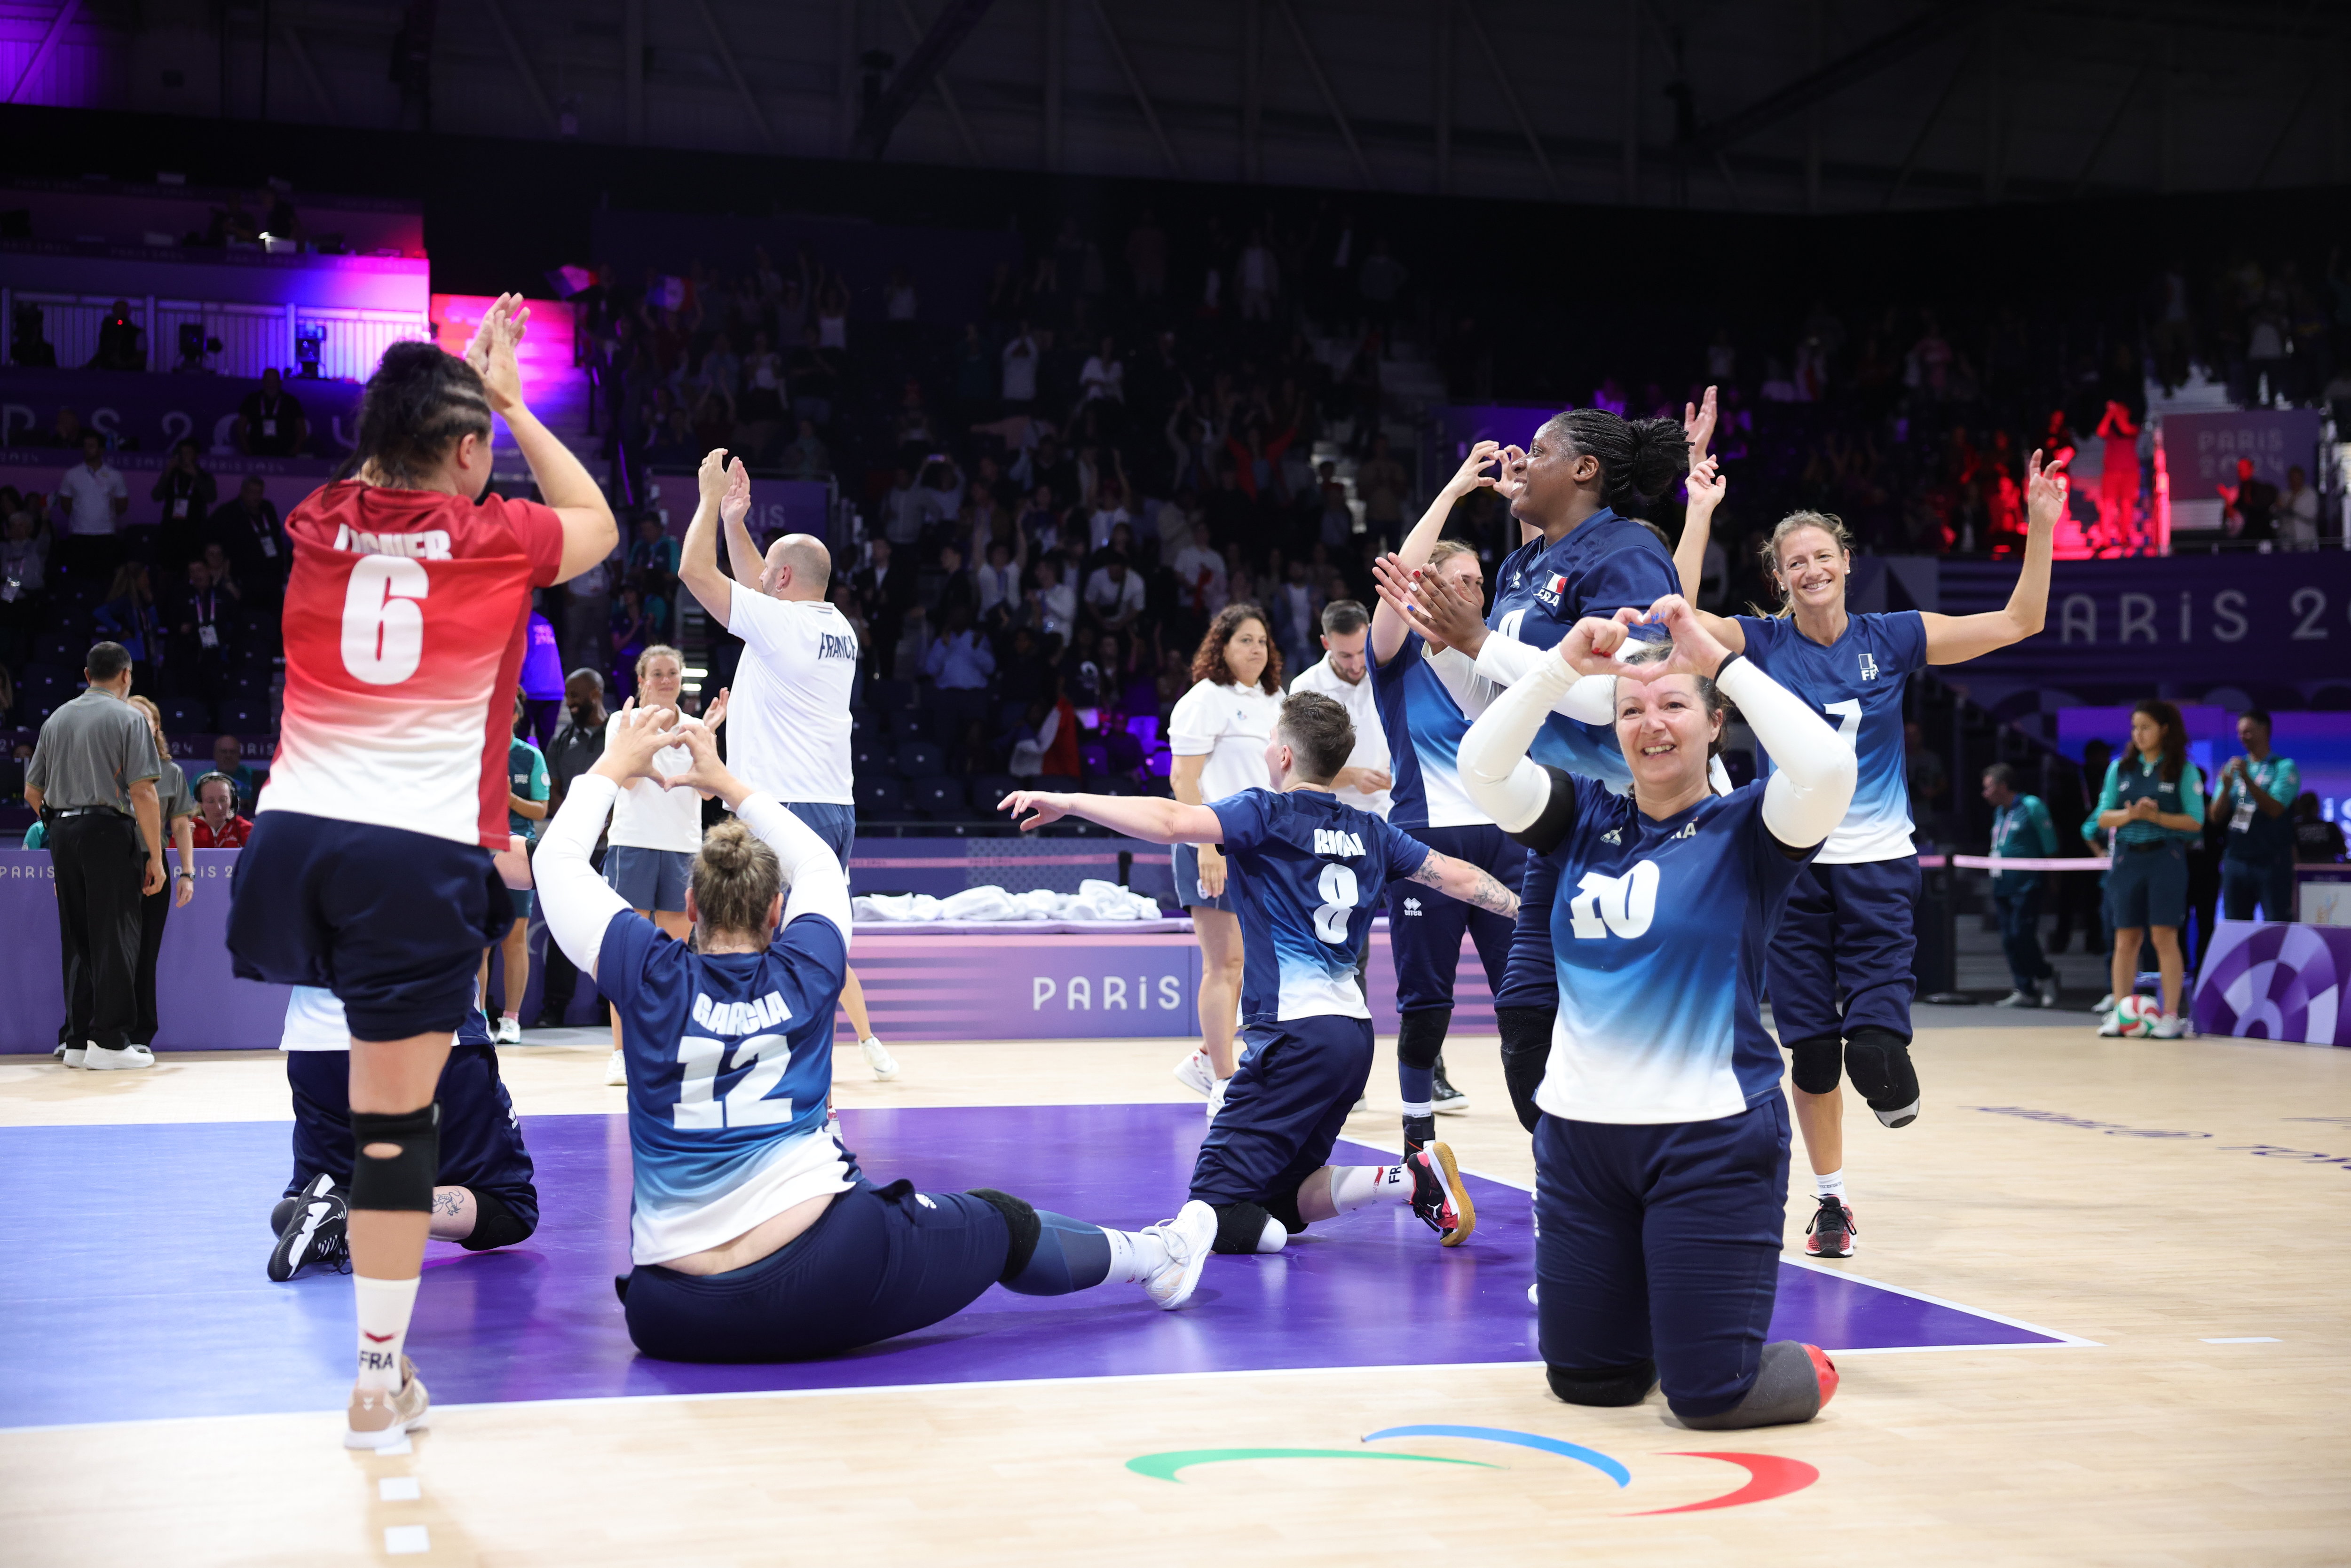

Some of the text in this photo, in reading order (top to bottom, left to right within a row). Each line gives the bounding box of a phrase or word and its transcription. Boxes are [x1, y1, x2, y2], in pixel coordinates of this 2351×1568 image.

[339, 554, 430, 686] 6
[1823, 698, 1863, 753] 7
[1313, 862, 1359, 944] 8
[1570, 859, 1660, 939] 10
[692, 990, 793, 1036] GARCIA
[672, 1034, 793, 1129] 12
[359, 1350, 394, 1370] FRA
